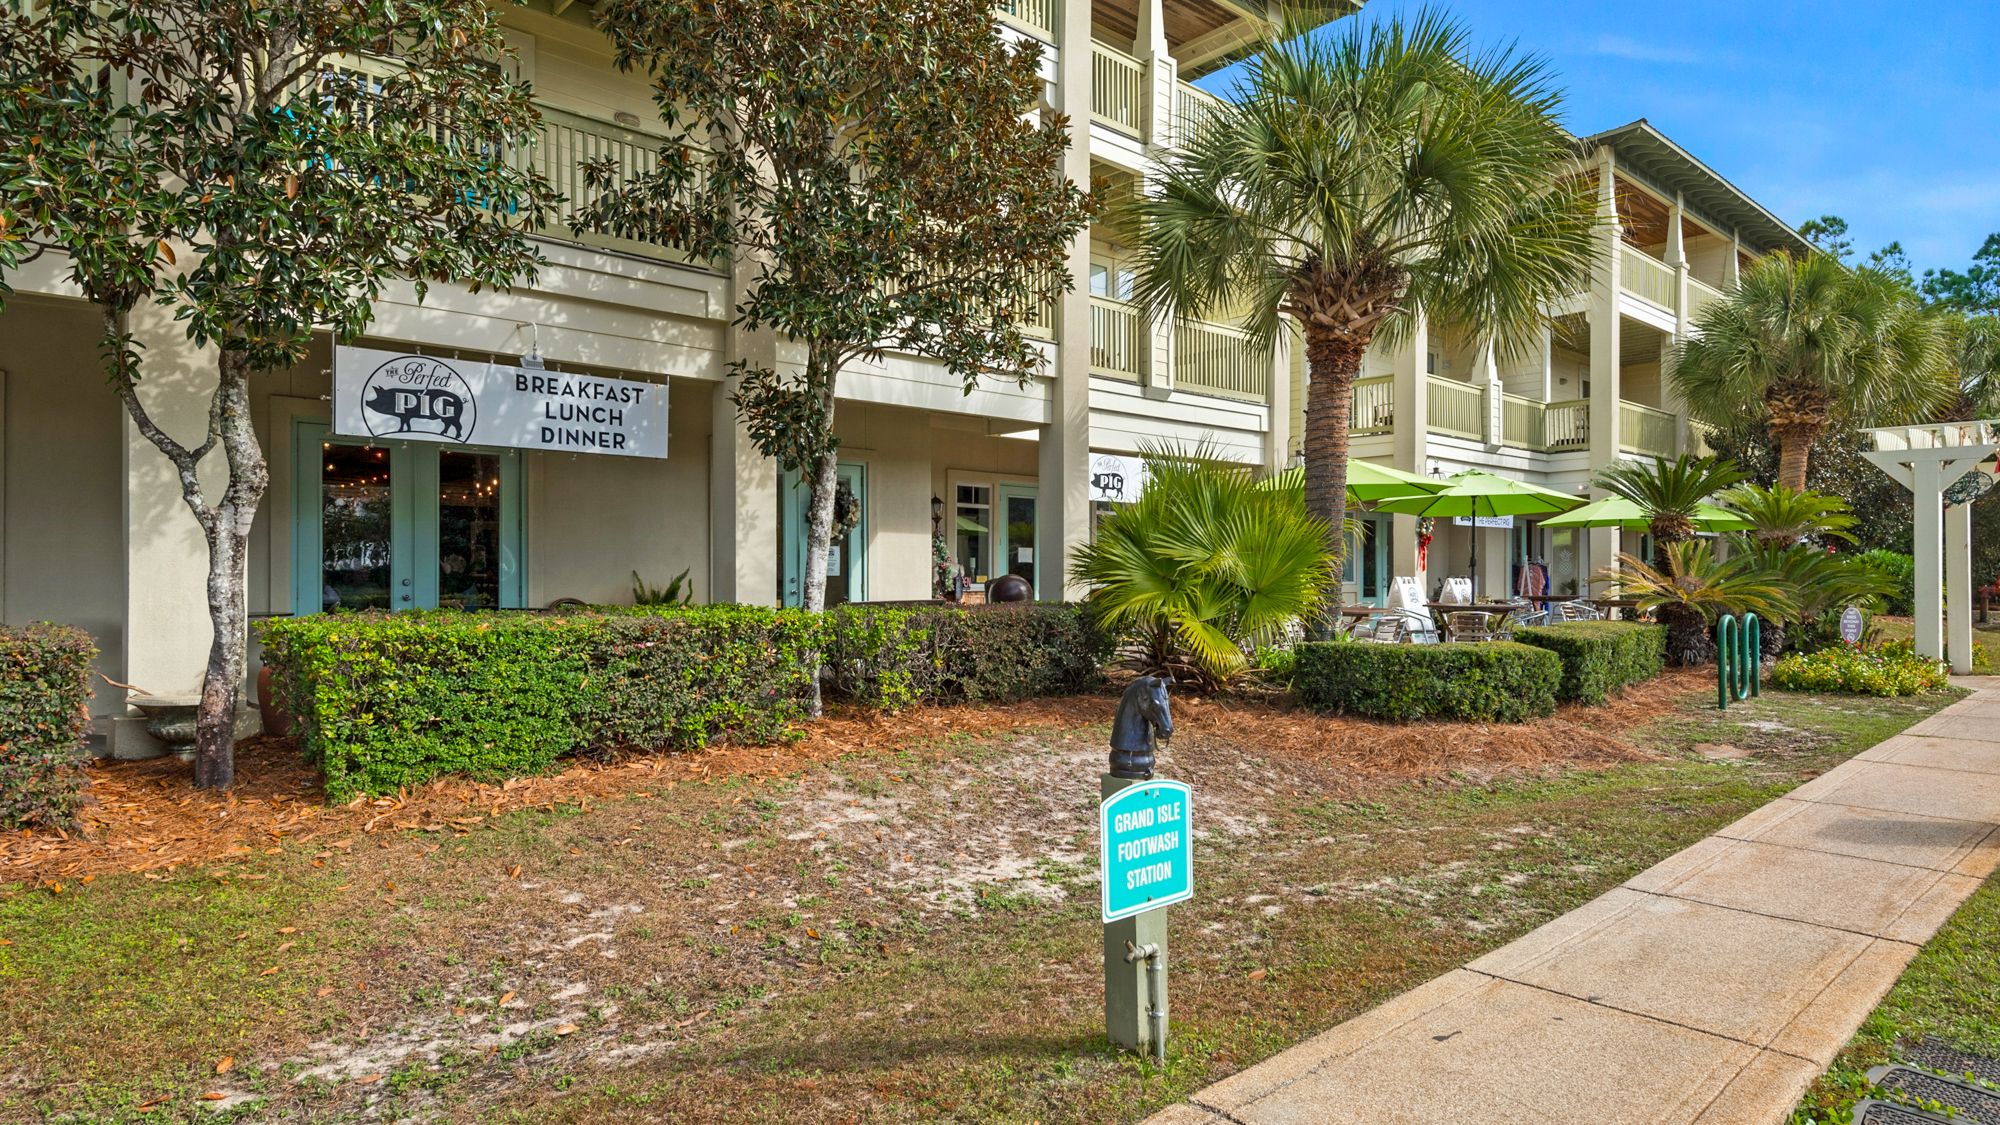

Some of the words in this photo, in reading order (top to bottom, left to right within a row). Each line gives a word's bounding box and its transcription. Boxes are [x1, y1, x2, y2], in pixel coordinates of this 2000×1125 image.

[385, 367, 399, 378] THE
[398, 361, 453, 397] Perfect
[515, 373, 644, 405] BREAKFAST
[394, 392, 456, 418] PIG
[545, 401, 623, 427] LUNCH
[541, 426, 626, 450] DINNER
[1099, 474, 1122, 489] PIG
[1115, 807, 1155, 834] GRAND
[1157, 801, 1181, 824] ISLE
[1117, 830, 1179, 863] FOOTWASH
[1126, 860, 1172, 890] STATION
